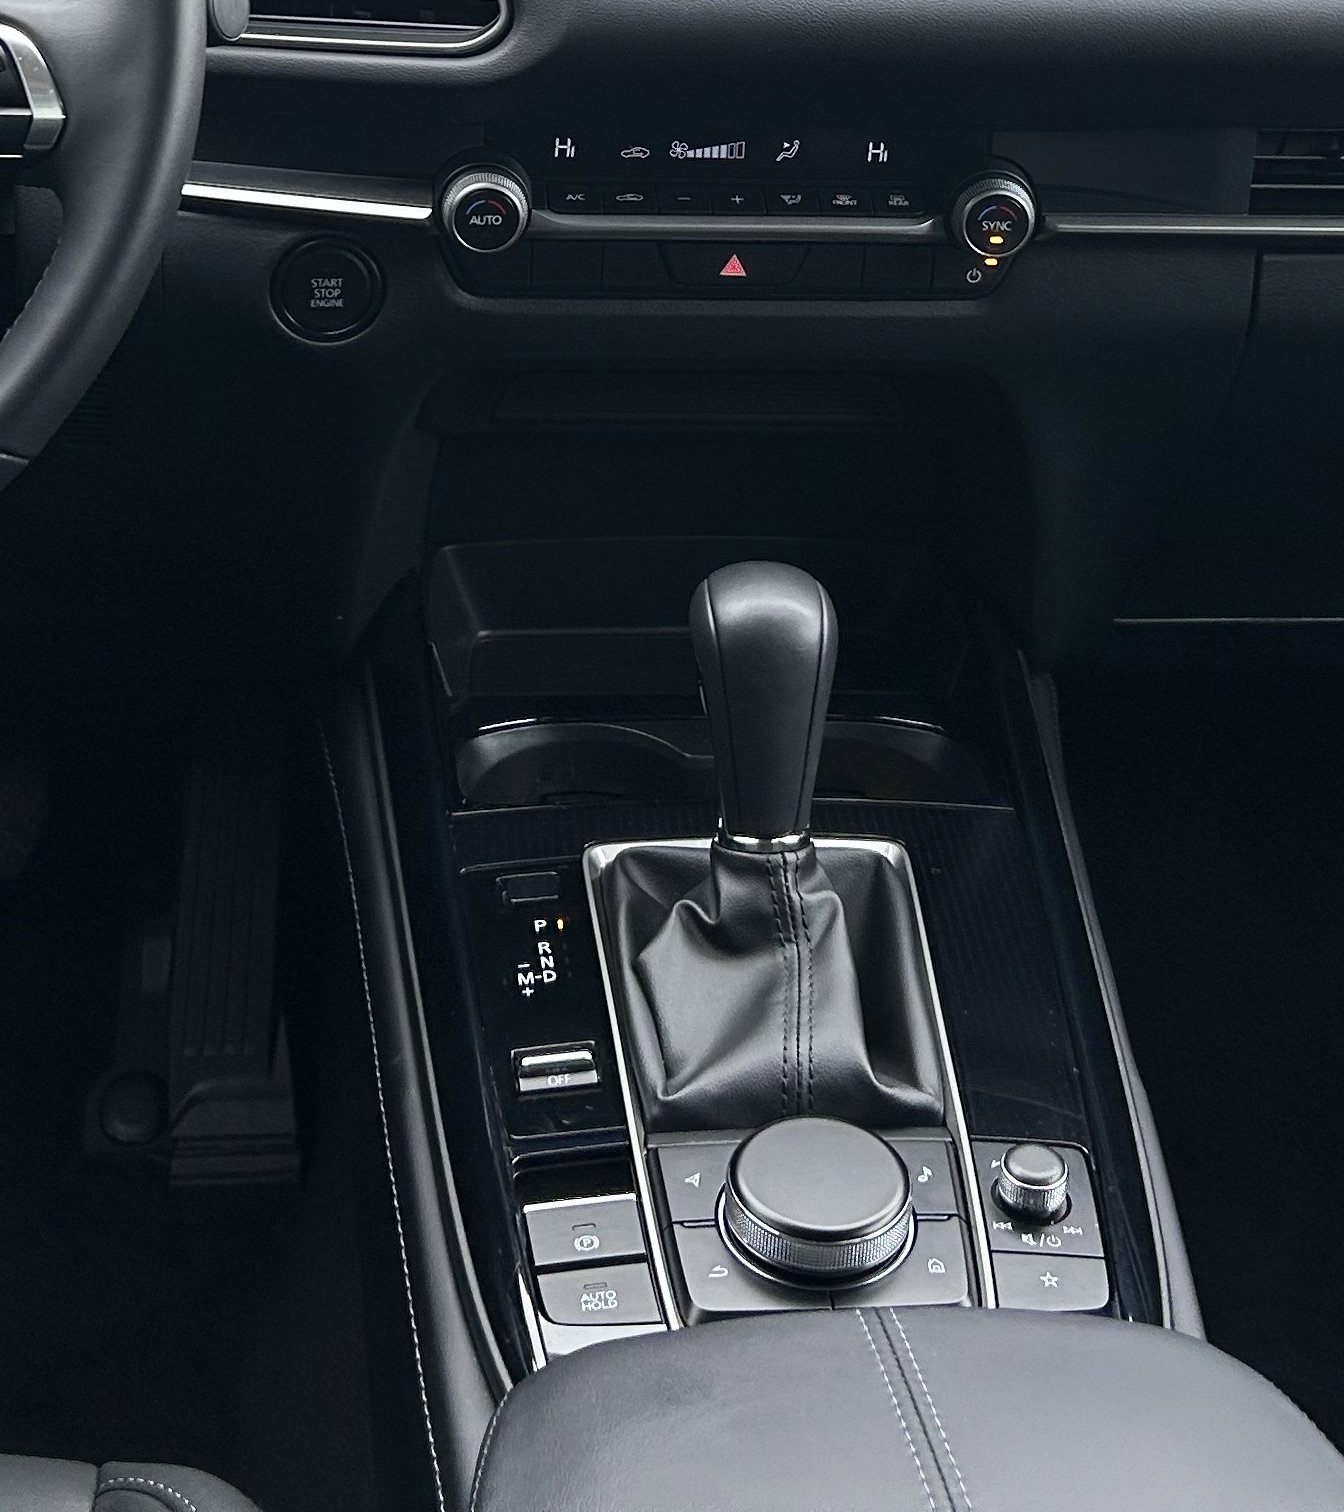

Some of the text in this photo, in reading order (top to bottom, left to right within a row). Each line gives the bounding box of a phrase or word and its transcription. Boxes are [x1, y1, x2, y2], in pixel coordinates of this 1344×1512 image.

[565, 193, 586, 201] A/C
[832, 199, 858, 207] FRONT
[468, 215, 503, 226] AUTO
[981, 220, 1012, 232] SYNC
[310, 278, 344, 288] START
[314, 288, 341, 298] STOP
[310, 299, 344, 307] ENGINE
[534, 919, 548, 934] P
[537, 941, 553, 955] R
[540, 955, 555, 969] N
[547, 1073, 571, 1086] OFF
[580, 1290, 617, 1303] AUTO
[581, 1299, 618, 1312] HOLD
